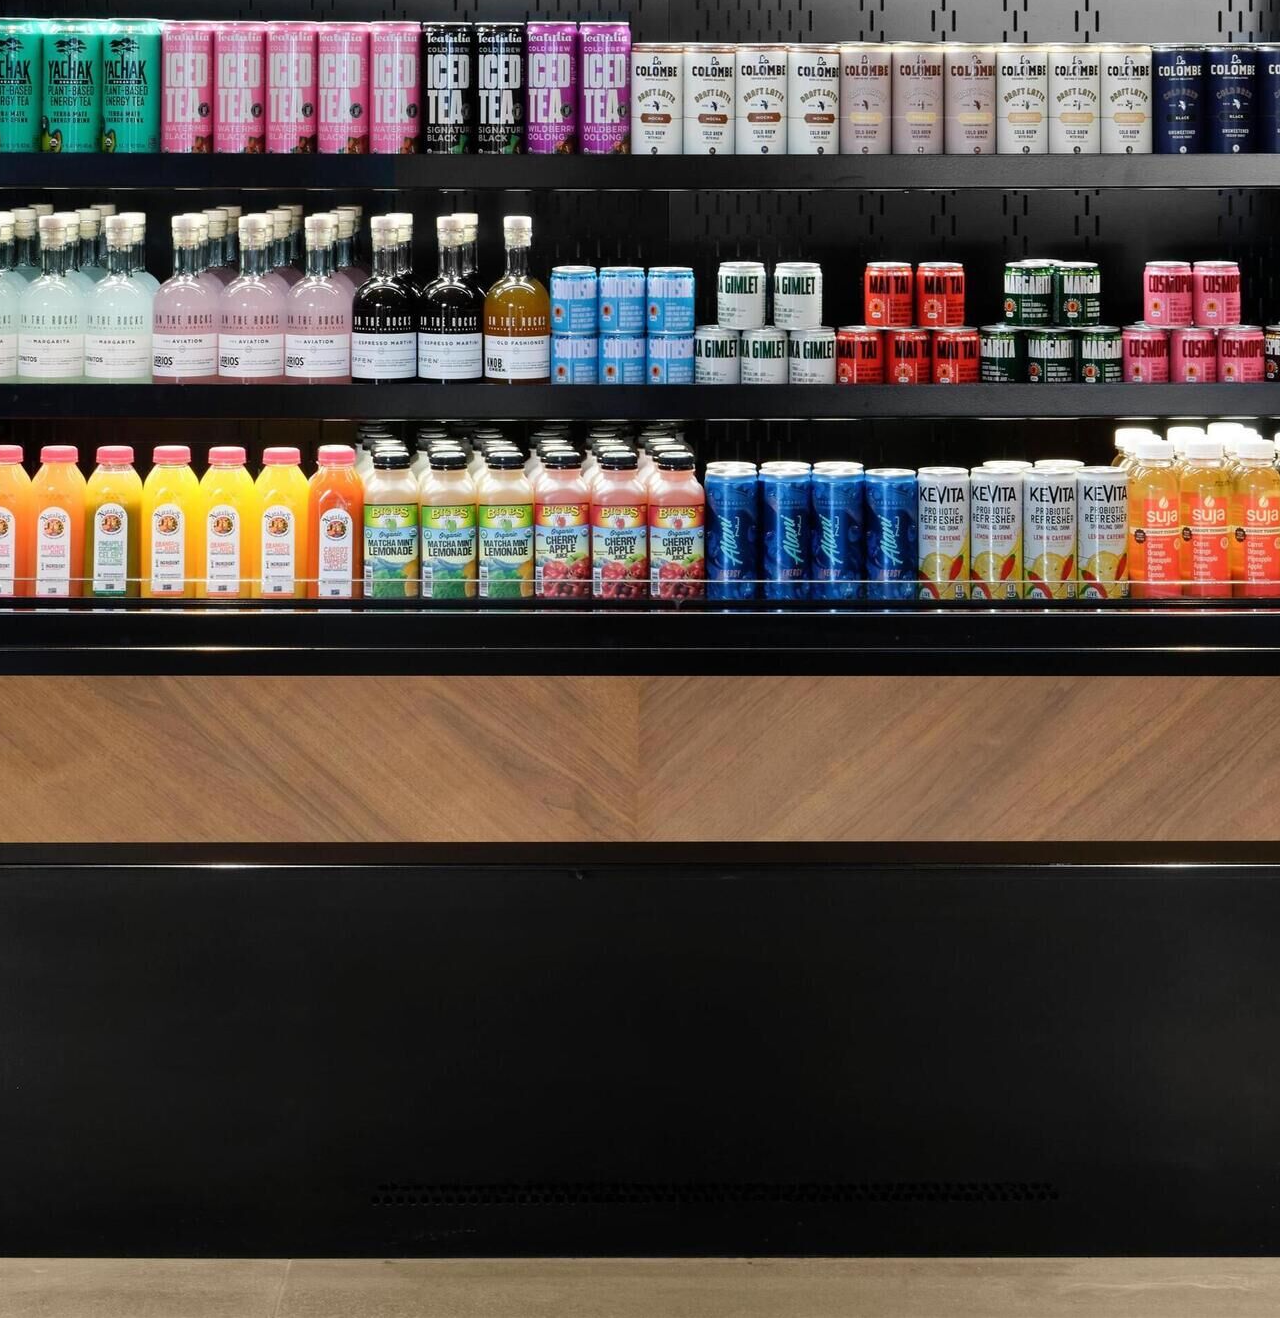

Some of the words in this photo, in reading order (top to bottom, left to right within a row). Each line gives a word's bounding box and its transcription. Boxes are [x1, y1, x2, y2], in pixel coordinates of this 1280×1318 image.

[478, 32, 522, 43] Teatulia
[528, 32, 572, 42] Teatulia
[49, 56, 92, 82] YACHAK
[374, 54, 415, 88] ICED
[479, 54, 520, 89] ICED
[528, 54, 570, 88] ICED
[636, 66, 678, 78] COLOMBE
[741, 64, 785, 76] COLOMBE
[1055, 65, 1099, 77] COLOMBE
[1158, 64, 1202, 77] COLOMBE
[48, 84, 94, 96] PLANT-BASED
[743, 89, 762, 102] DRAFT
[50, 96, 77, 106] ENERGY
[78, 97, 91, 106] TEA
[374, 89, 407, 123] TEA
[479, 89, 514, 124] TEA
[529, 89, 563, 123] TEA
[479, 134, 507, 142] BLACK
[528, 133, 564, 141] OOLONG
[724, 276, 758, 294] GIMLET
[894, 276, 909, 294] TAI
[366, 316, 380, 327] THE
[387, 316, 412, 327] ROCKS
[500, 316, 514, 326] THE
[522, 316, 546, 327] ROCKS
[752, 340, 785, 359] GIMLET
[937, 341, 958, 359] MAI
[487, 357, 503, 369] KNOB
[920, 487, 965, 503] KEVITA
[1030, 487, 1075, 504] KEVITA
[924, 507, 959, 516] PROBIOTIC
[1192, 508, 1225, 525] suja
[1247, 508, 1278, 525] suja
[921, 515, 963, 524] REFRESHER
[1031, 515, 1074, 524] REFRESHER
[546, 534, 578, 545] CHERRY
[662, 536, 694, 547] CHERRY
[718, 515, 743, 566] Alani
[878, 515, 903, 566] Alani
[369, 546, 413, 555] LEMONADE
[484, 547, 528, 556] LEMONADE
[549, 543, 576, 554] APPLE
[666, 545, 692, 557] APPLE
